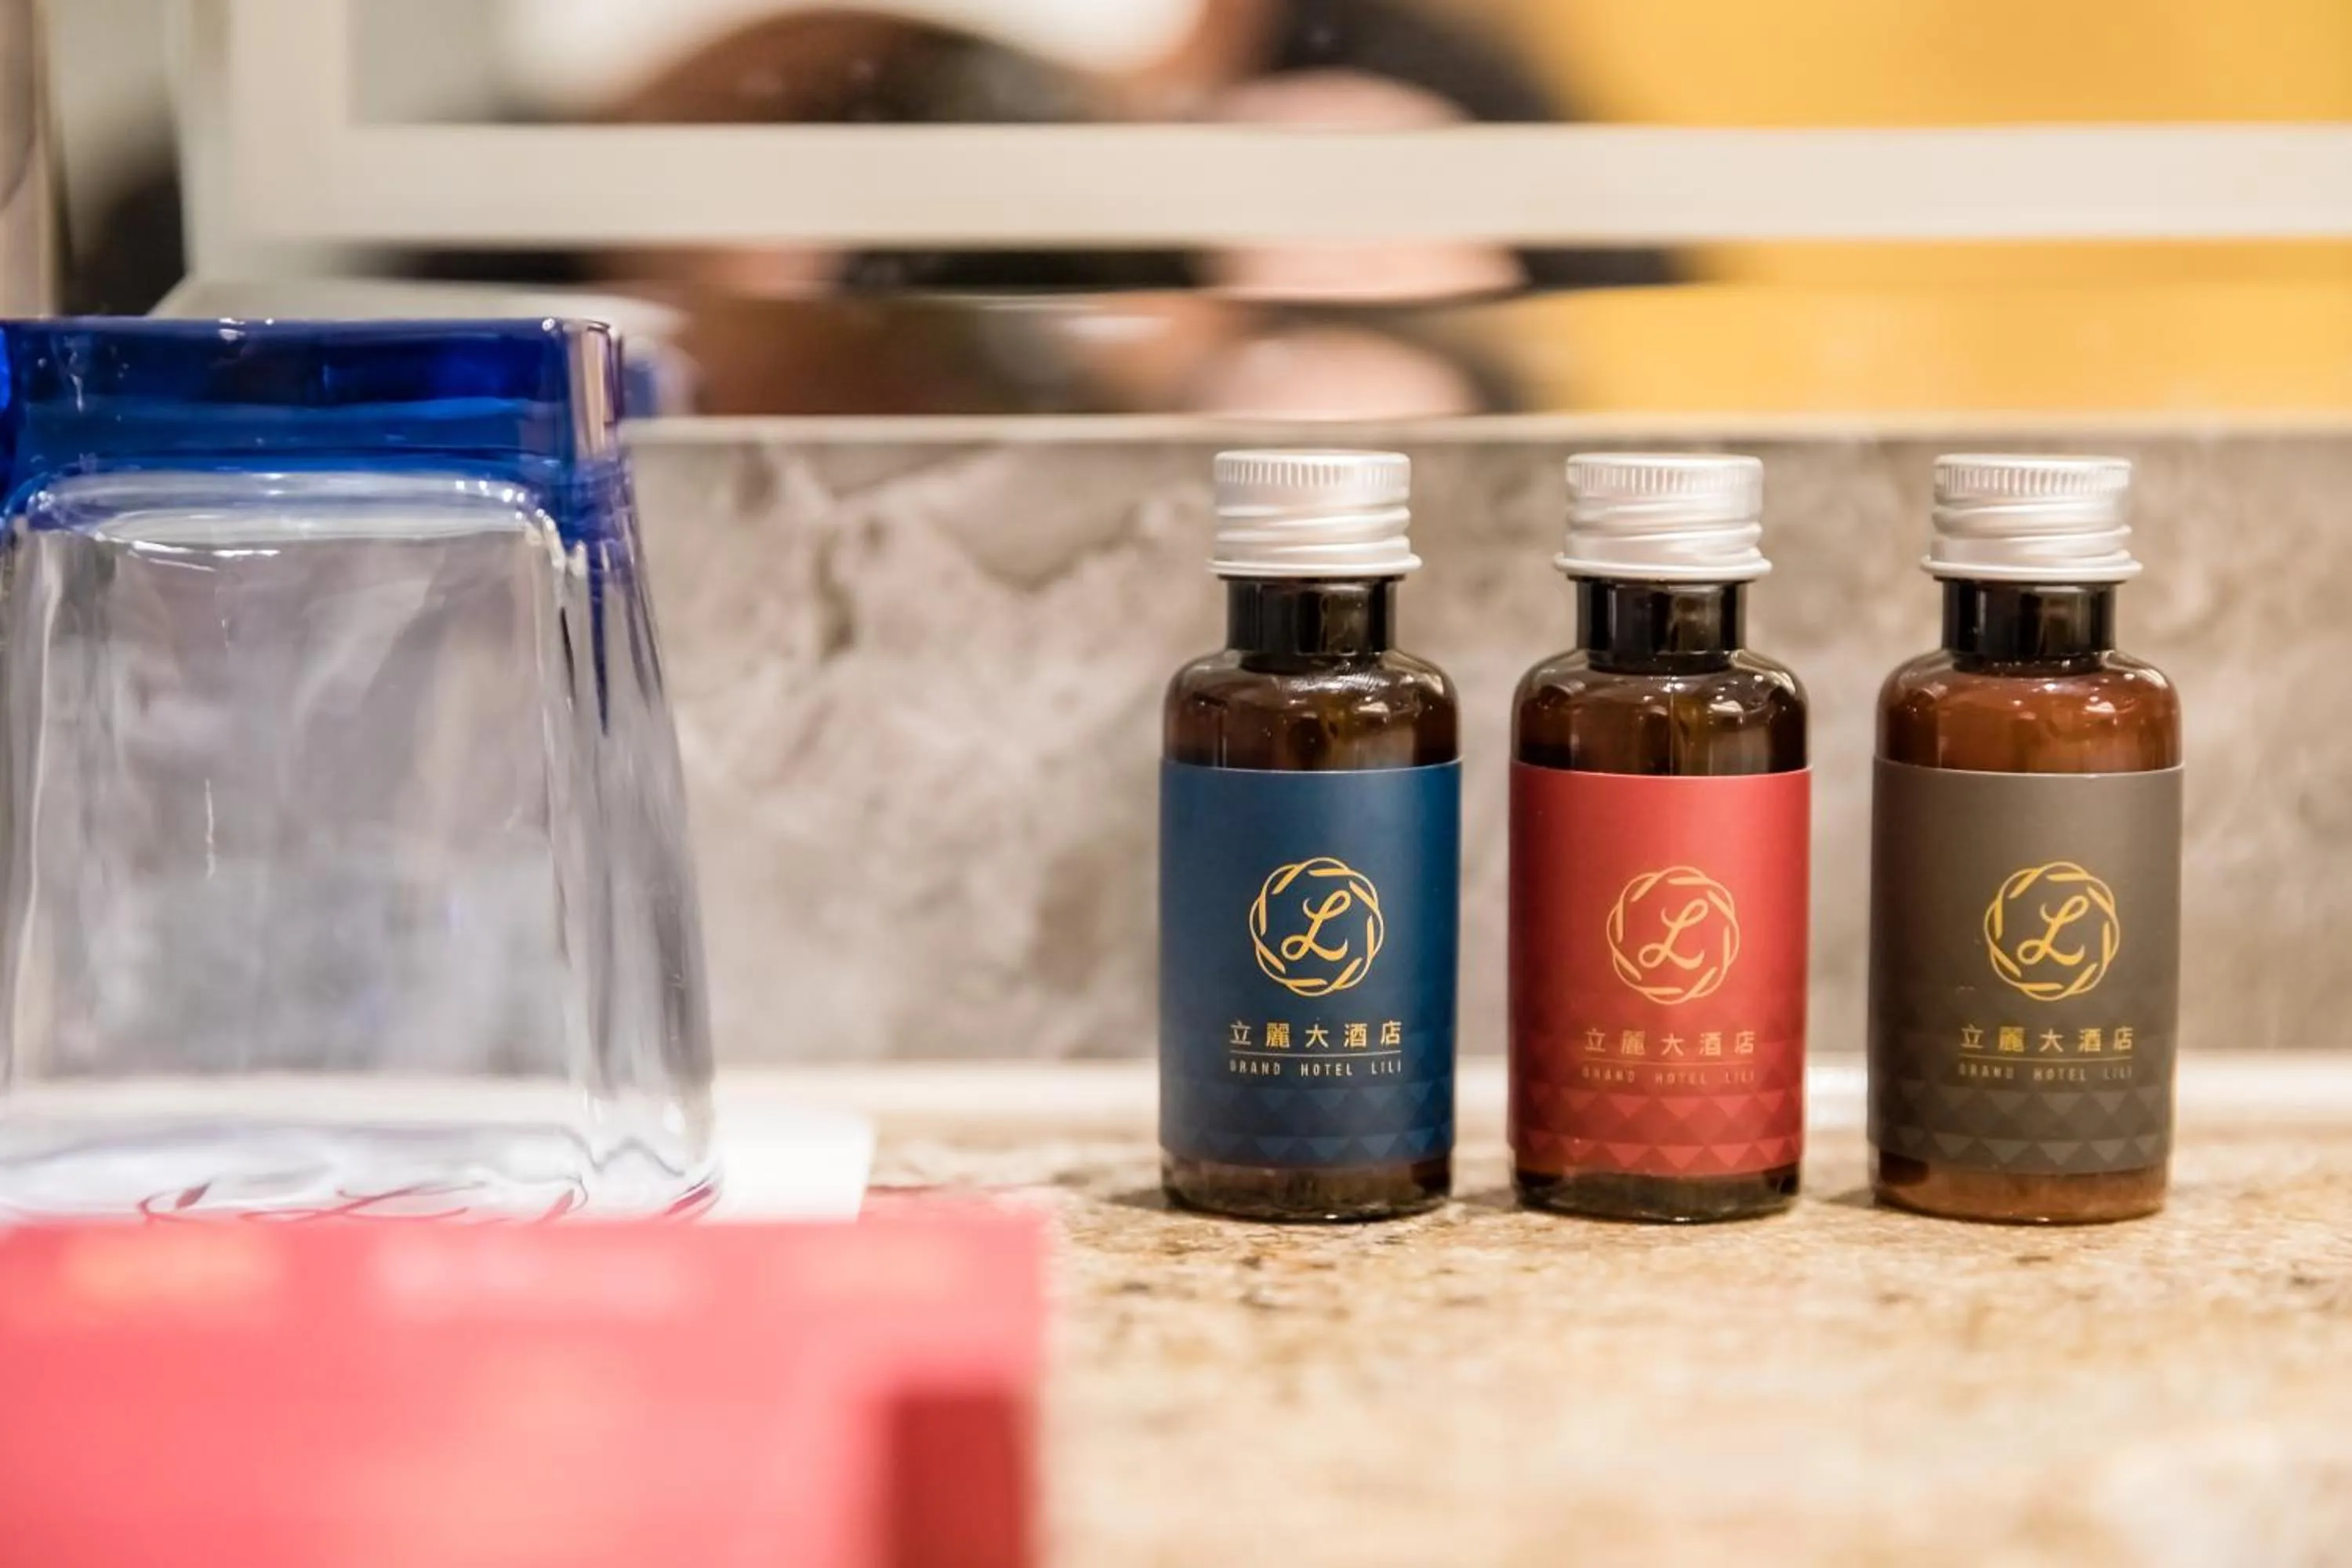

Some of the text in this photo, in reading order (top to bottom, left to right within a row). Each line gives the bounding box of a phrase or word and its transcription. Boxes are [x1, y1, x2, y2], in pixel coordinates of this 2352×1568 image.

[1280, 889, 1351, 961] L
[1638, 898, 1708, 970] L
[2016, 895, 2089, 966] L
[1229, 1021, 1402, 1049] 立麗大酒店
[1584, 1028, 1755, 1057] 立麗大酒店
[1961, 1025, 2133, 1053] 立麗大酒店
[1229, 1059, 1402, 1077] GRAND HOTEL LILI
[1655, 1072, 1707, 1085] HOTEL
[2034, 1068, 2087, 1082] HOTEL
